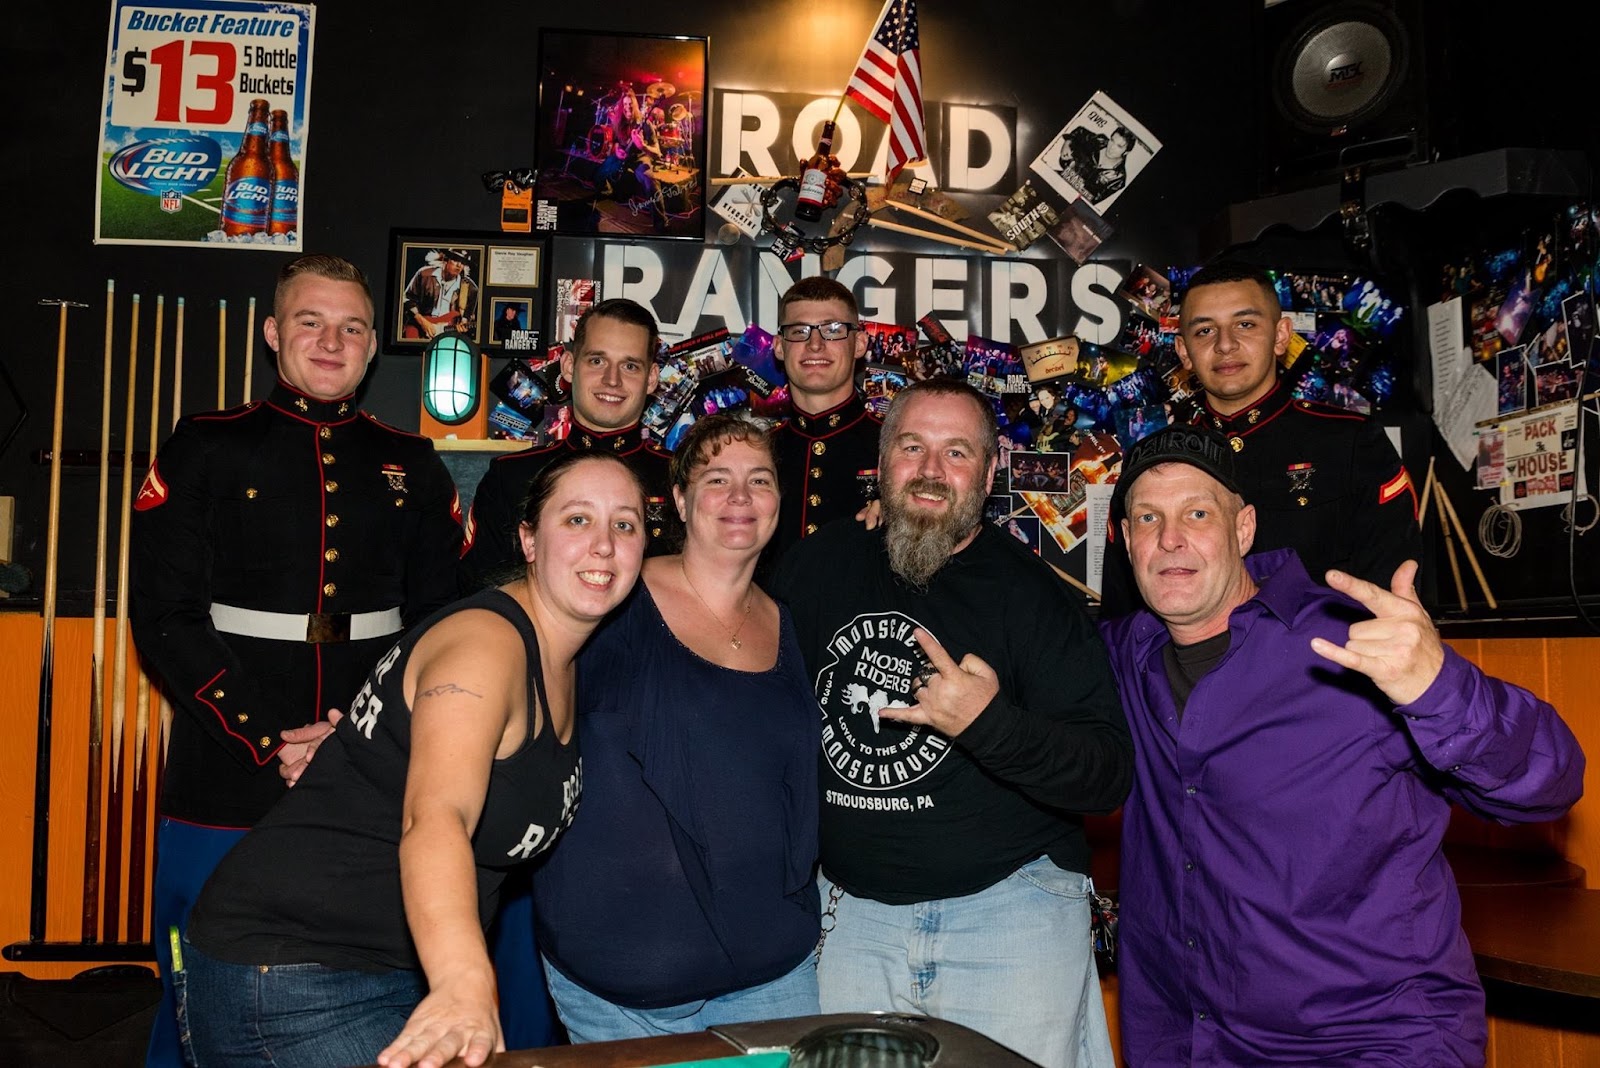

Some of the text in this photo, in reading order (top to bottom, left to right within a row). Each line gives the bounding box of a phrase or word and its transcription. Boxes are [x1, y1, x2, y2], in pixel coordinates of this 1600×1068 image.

[127, 10, 295, 38] Bucket Feature
[243, 46, 297, 69] 5 Bottle
[121, 39, 237, 125] $13
[1328, 62, 1364, 82] MTX
[239, 72, 294, 96] Buckets
[143, 148, 209, 166] BUD
[126, 165, 216, 182] LIGHT
[235, 181, 268, 195] BUD
[163, 199, 179, 209] NFL
[1005, 208, 1041, 242] SOUTH
[603, 243, 1124, 345] RANGERS
[505, 339, 537, 350] RANGER'S
[512, 330, 528, 340] ROAD
[1007, 374, 1023, 384] ROAD
[1525, 419, 1557, 440] PACK
[1517, 452, 1567, 477] HOUSE
[861, 646, 913, 677] MOOSE
[854, 661, 911, 694] RIDERS
[838, 716, 921, 757] LOYAL TO THE BONE
[822, 724, 947, 785] MOOSEHAVEN
[826, 790, 935, 812] STROUDSBURG, PA
